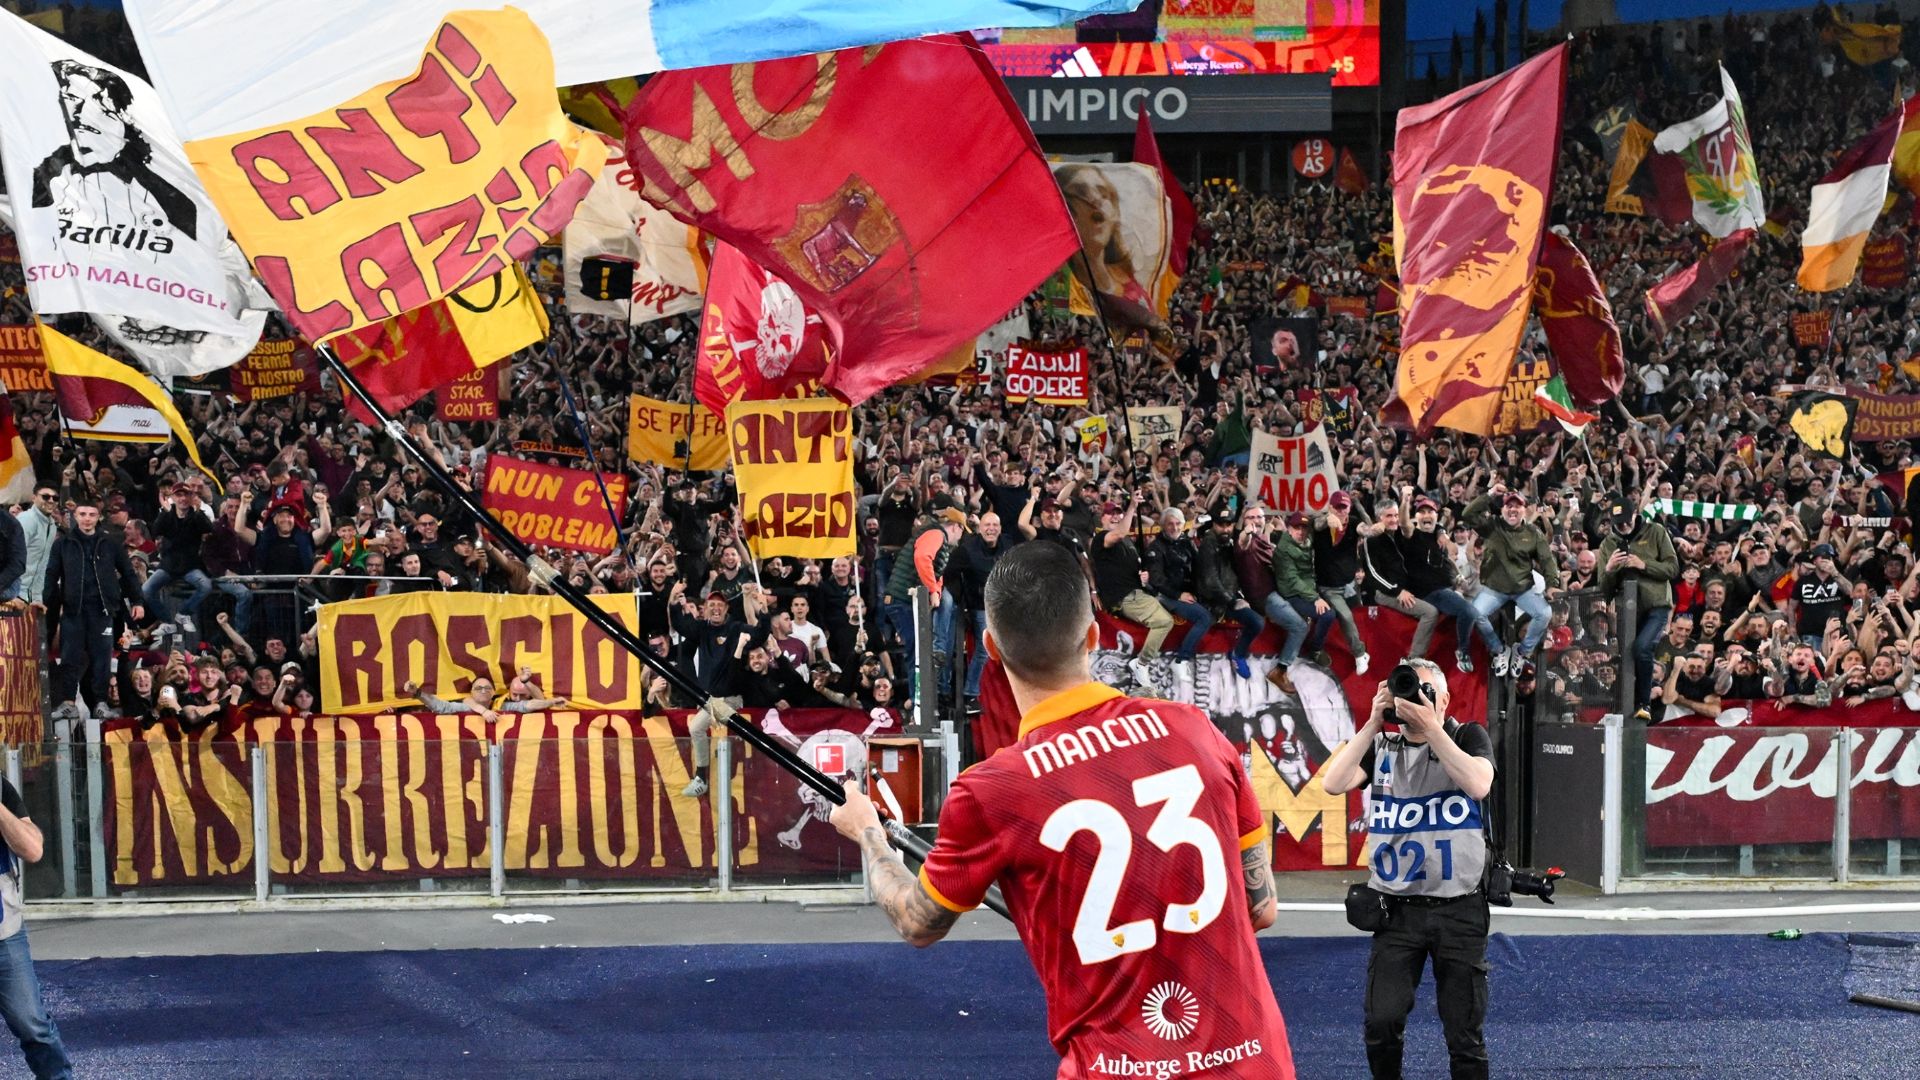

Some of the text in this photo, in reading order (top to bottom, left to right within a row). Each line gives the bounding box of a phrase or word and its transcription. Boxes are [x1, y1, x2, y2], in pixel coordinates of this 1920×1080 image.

[1028, 87, 1188, 122] IMPICO
[1303, 139, 1323, 155] 19
[1302, 156, 1325, 174] AS
[247, 353, 291, 370] FERMA
[250, 340, 295, 354] ESSUNO
[241, 370, 255, 386] IL
[258, 369, 304, 385] NOSTRO
[449, 384, 485, 400] STAR
[1006, 373, 1084, 397] GODERE
[444, 401, 493, 417] CON TE
[637, 406, 662, 432] SE
[703, 413, 726, 437] FA
[1277, 437, 1307, 475] TI
[487, 465, 564, 502] NUN
[1257, 472, 1329, 513] AMO
[1801, 582, 1839, 598] EA7
[334, 612, 628, 707] ROSCIO
[1023, 709, 1170, 779] MANCINI
[1369, 795, 1471, 829] PHOTO
[1039, 763, 1229, 966] 23
[1373, 839, 1453, 883] 021
[1089, 1039, 1262, 1080] Auberge Resorts
